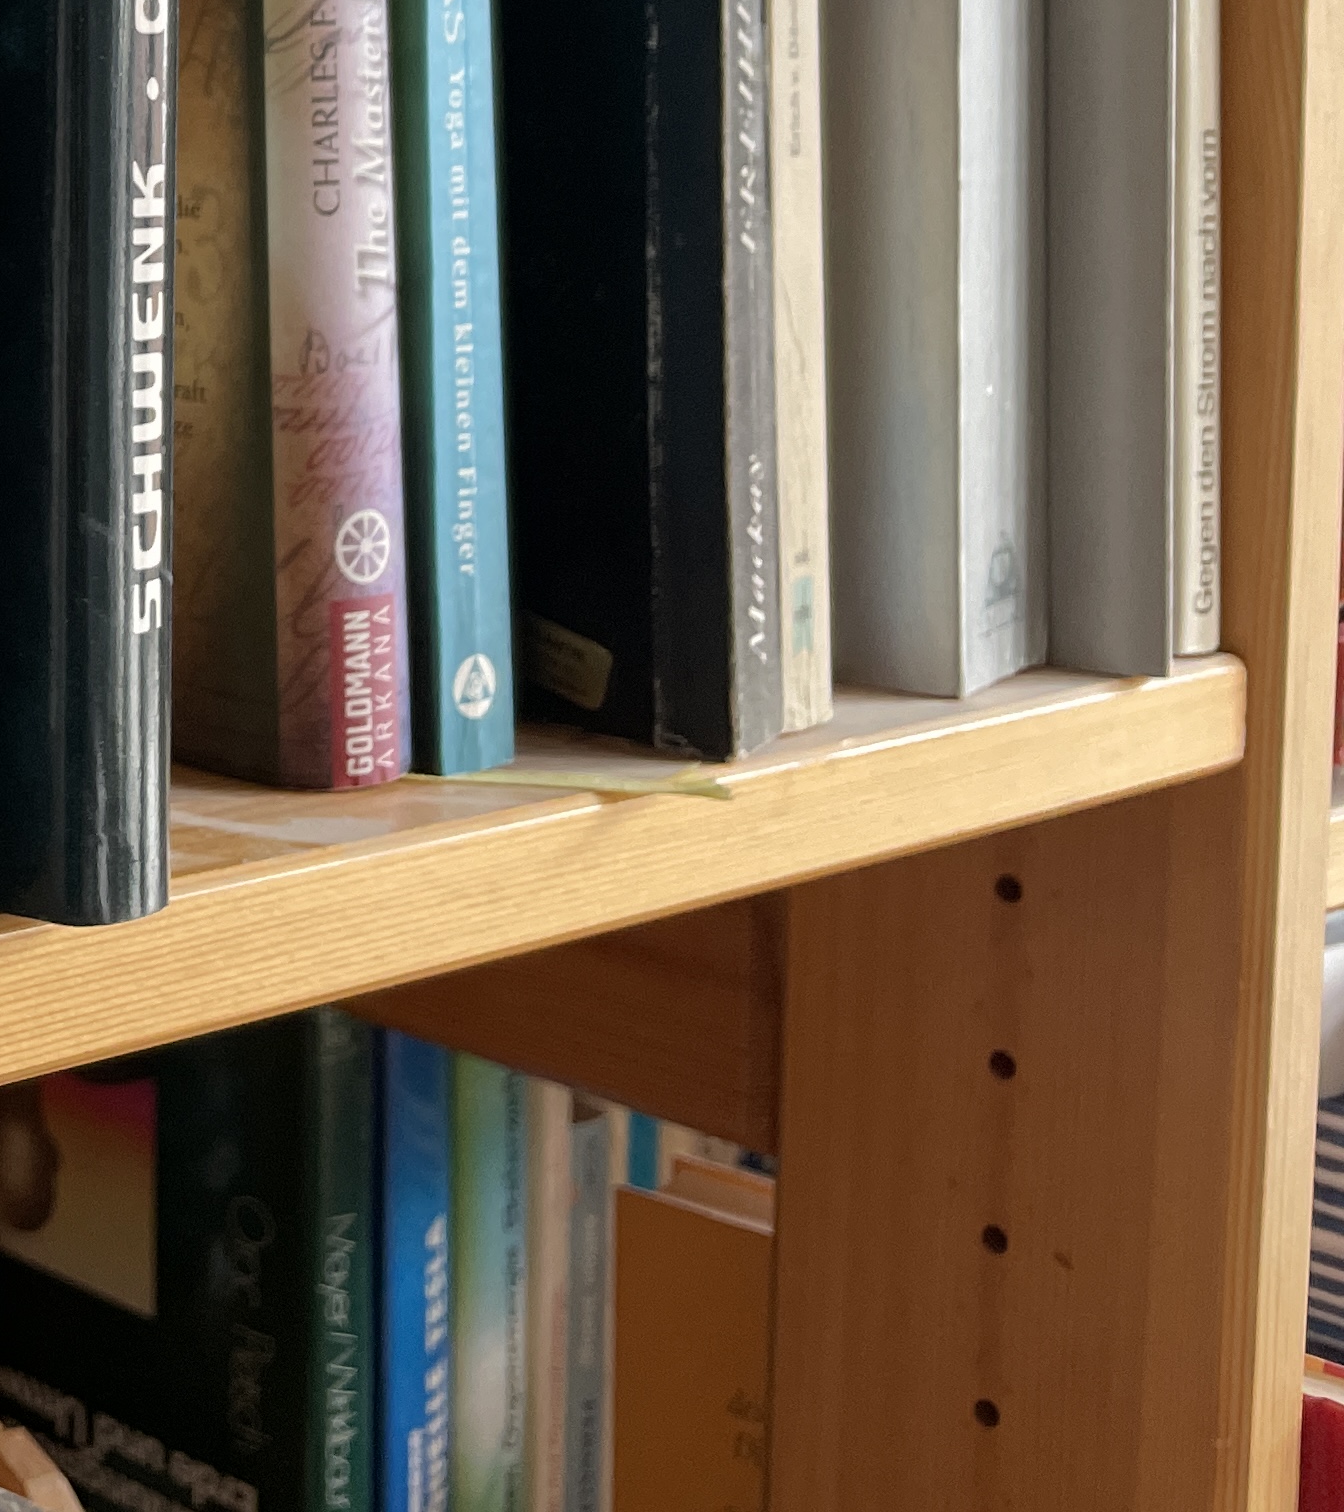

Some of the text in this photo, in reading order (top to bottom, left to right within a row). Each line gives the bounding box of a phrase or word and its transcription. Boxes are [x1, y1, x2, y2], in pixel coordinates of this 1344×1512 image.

[310, 2, 337, 28] F.
[310, 39, 341, 217] CHARLES
[350, 2, 388, 185] Master
[354, 193, 391, 289] The
[1197, 213, 1217, 301] nach
[445, 66, 477, 577] Yoga mit dem kleinen Finger
[1196, 310, 1217, 417] Strom
[131, 160, 164, 638] SCHWENK
[1192, 425, 1215, 492] den
[1191, 501, 1218, 616] Gegen
[342, 610, 375, 777] GOLDMANN
[372, 605, 394, 767] ARKANA
